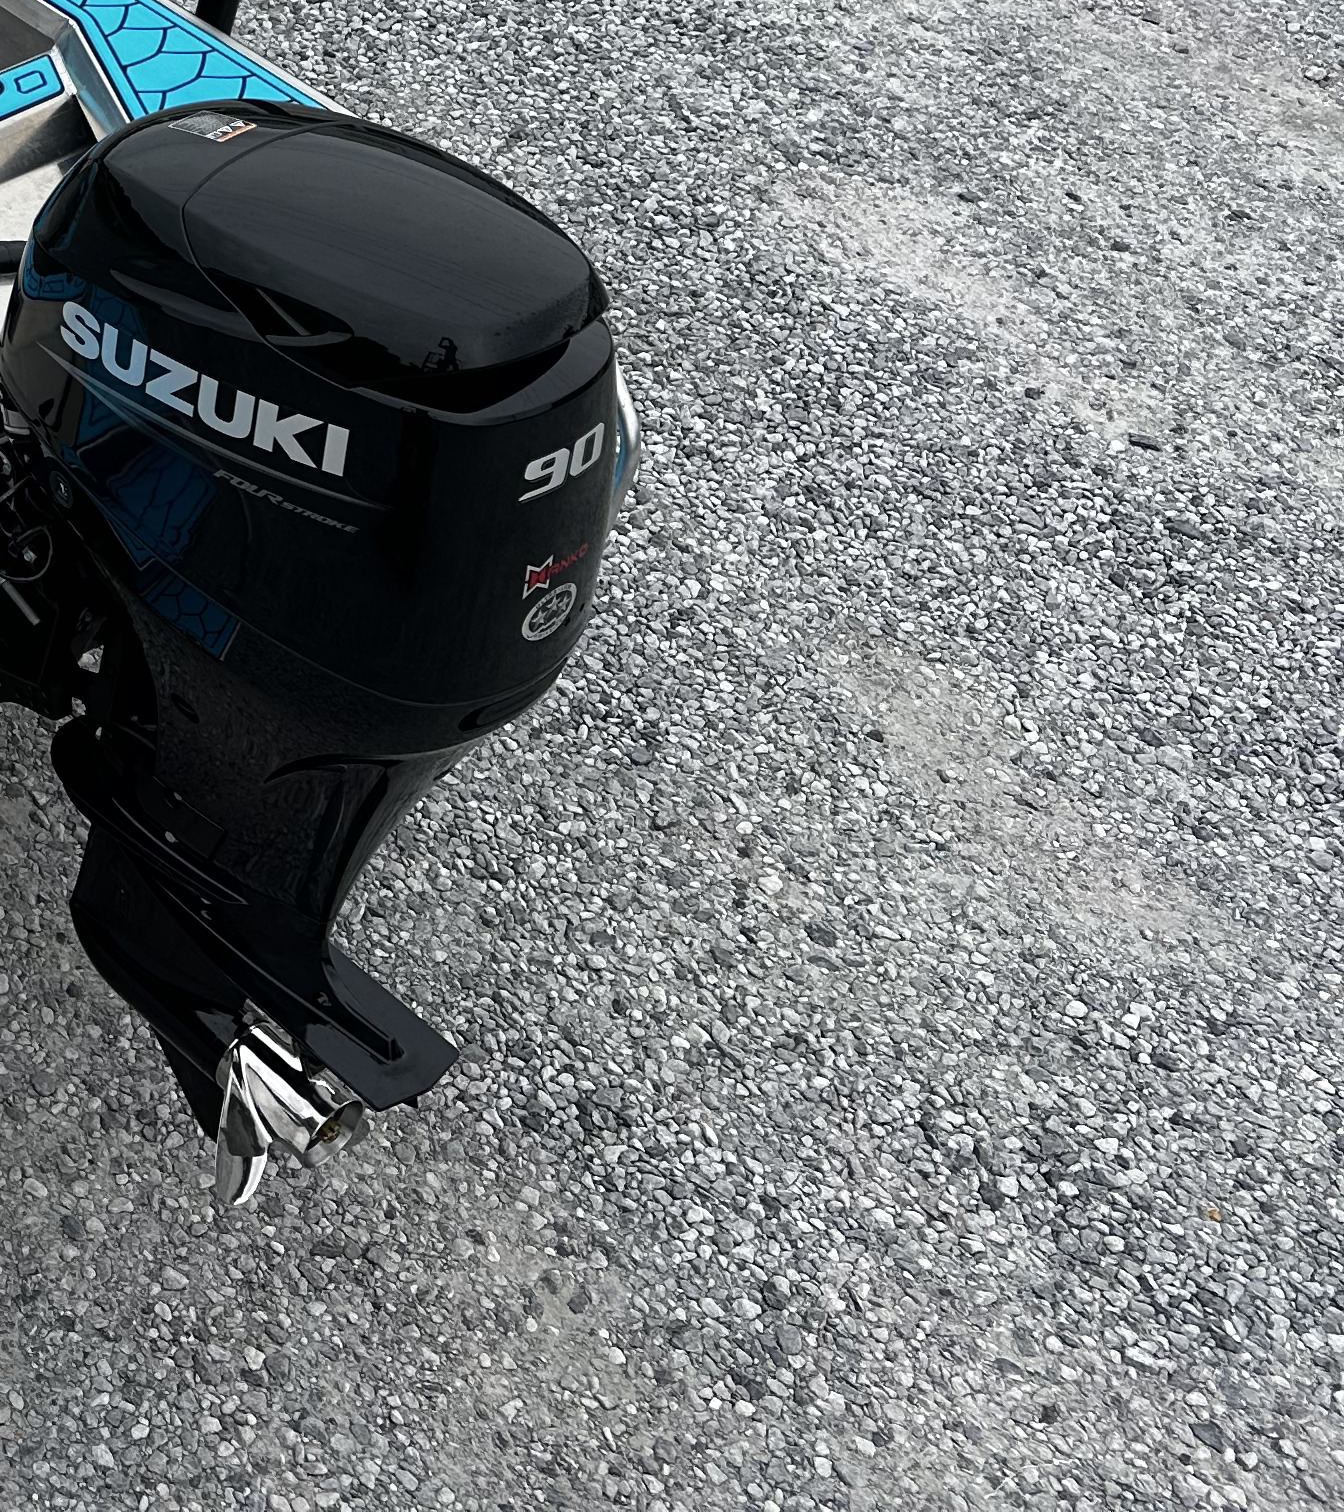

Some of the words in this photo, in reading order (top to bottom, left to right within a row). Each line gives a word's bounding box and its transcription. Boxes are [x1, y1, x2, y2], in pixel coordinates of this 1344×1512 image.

[60, 301, 350, 477] SUZUKI
[213, 469, 283, 506] FOUR
[280, 501, 360, 534] STROKE
[518, 422, 605, 503] 90
